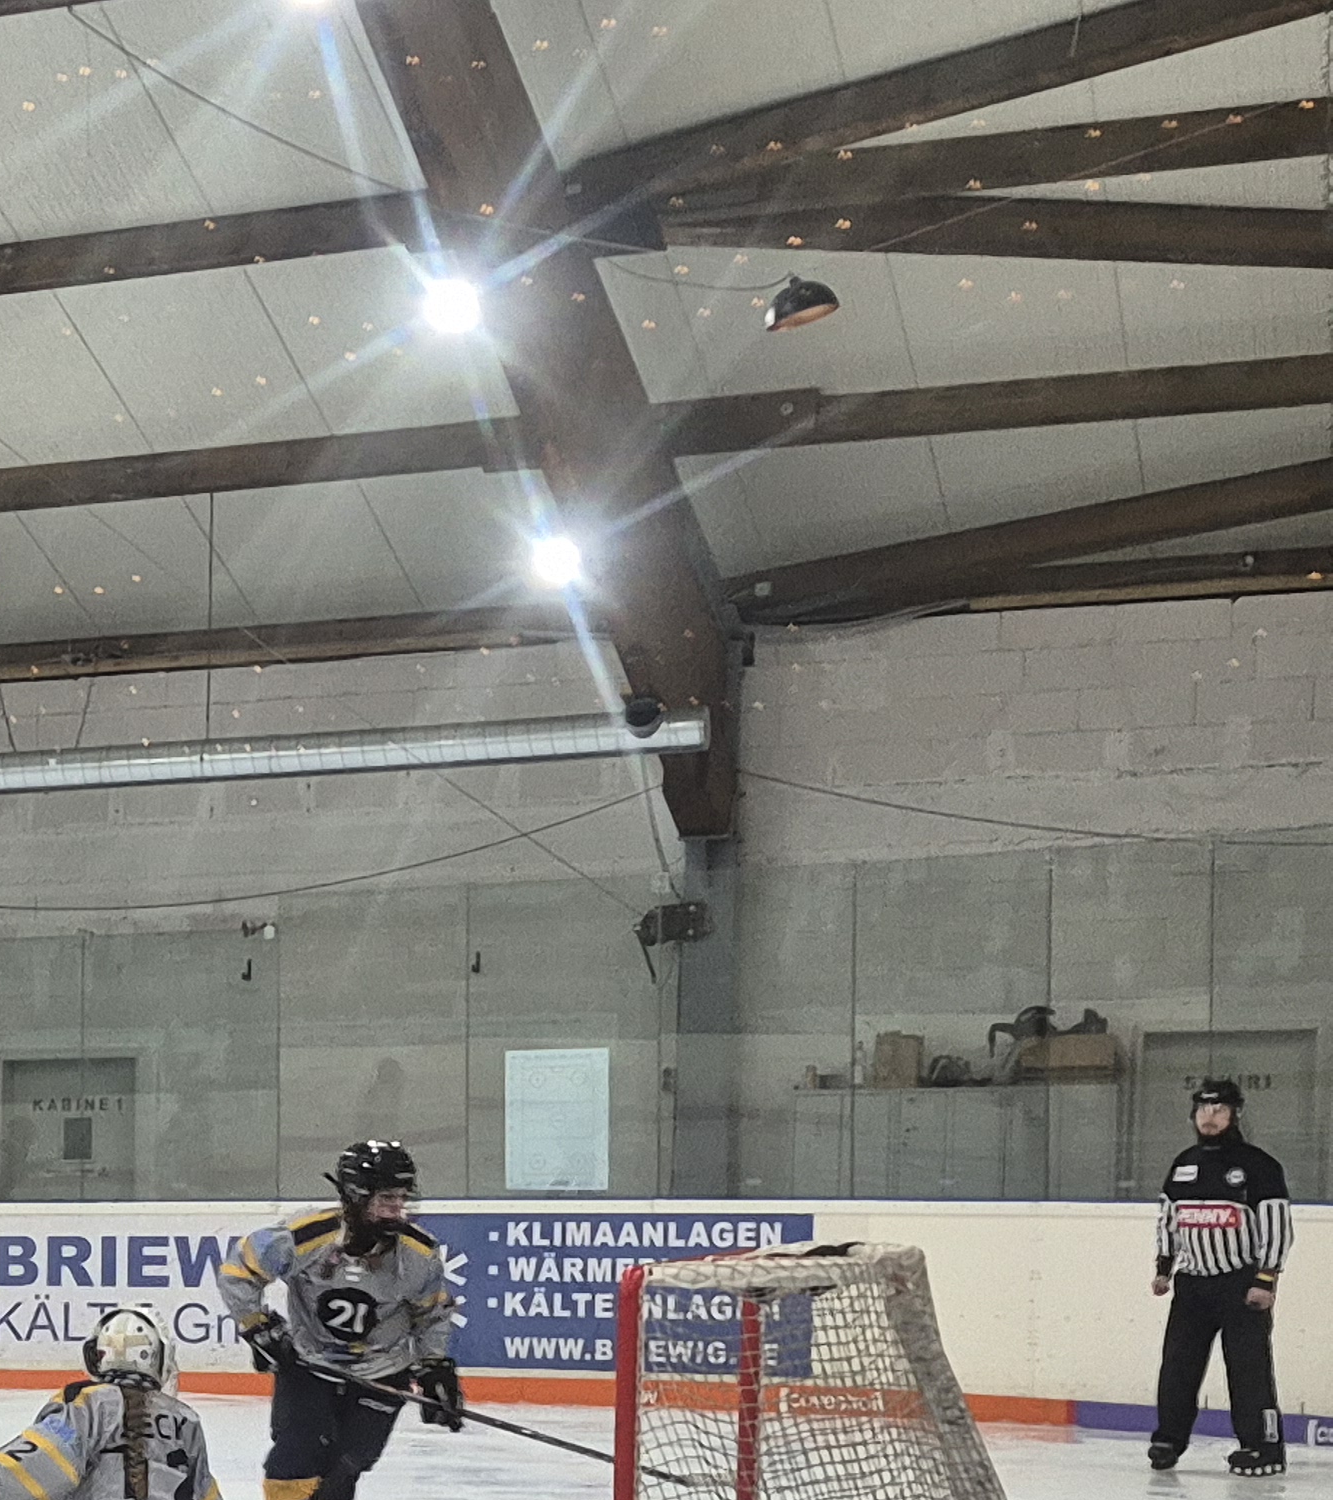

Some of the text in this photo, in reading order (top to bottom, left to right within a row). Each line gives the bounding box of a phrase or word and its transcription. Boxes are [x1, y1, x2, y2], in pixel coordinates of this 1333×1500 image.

[506, 1221, 782, 1248] KLIMAANLAGEN
[324, 1298, 370, 1334] 21
[503, 1287, 781, 1322] KÄLTENLAGN
[504, 1336, 779, 1367] WWW.BEWIG.E
